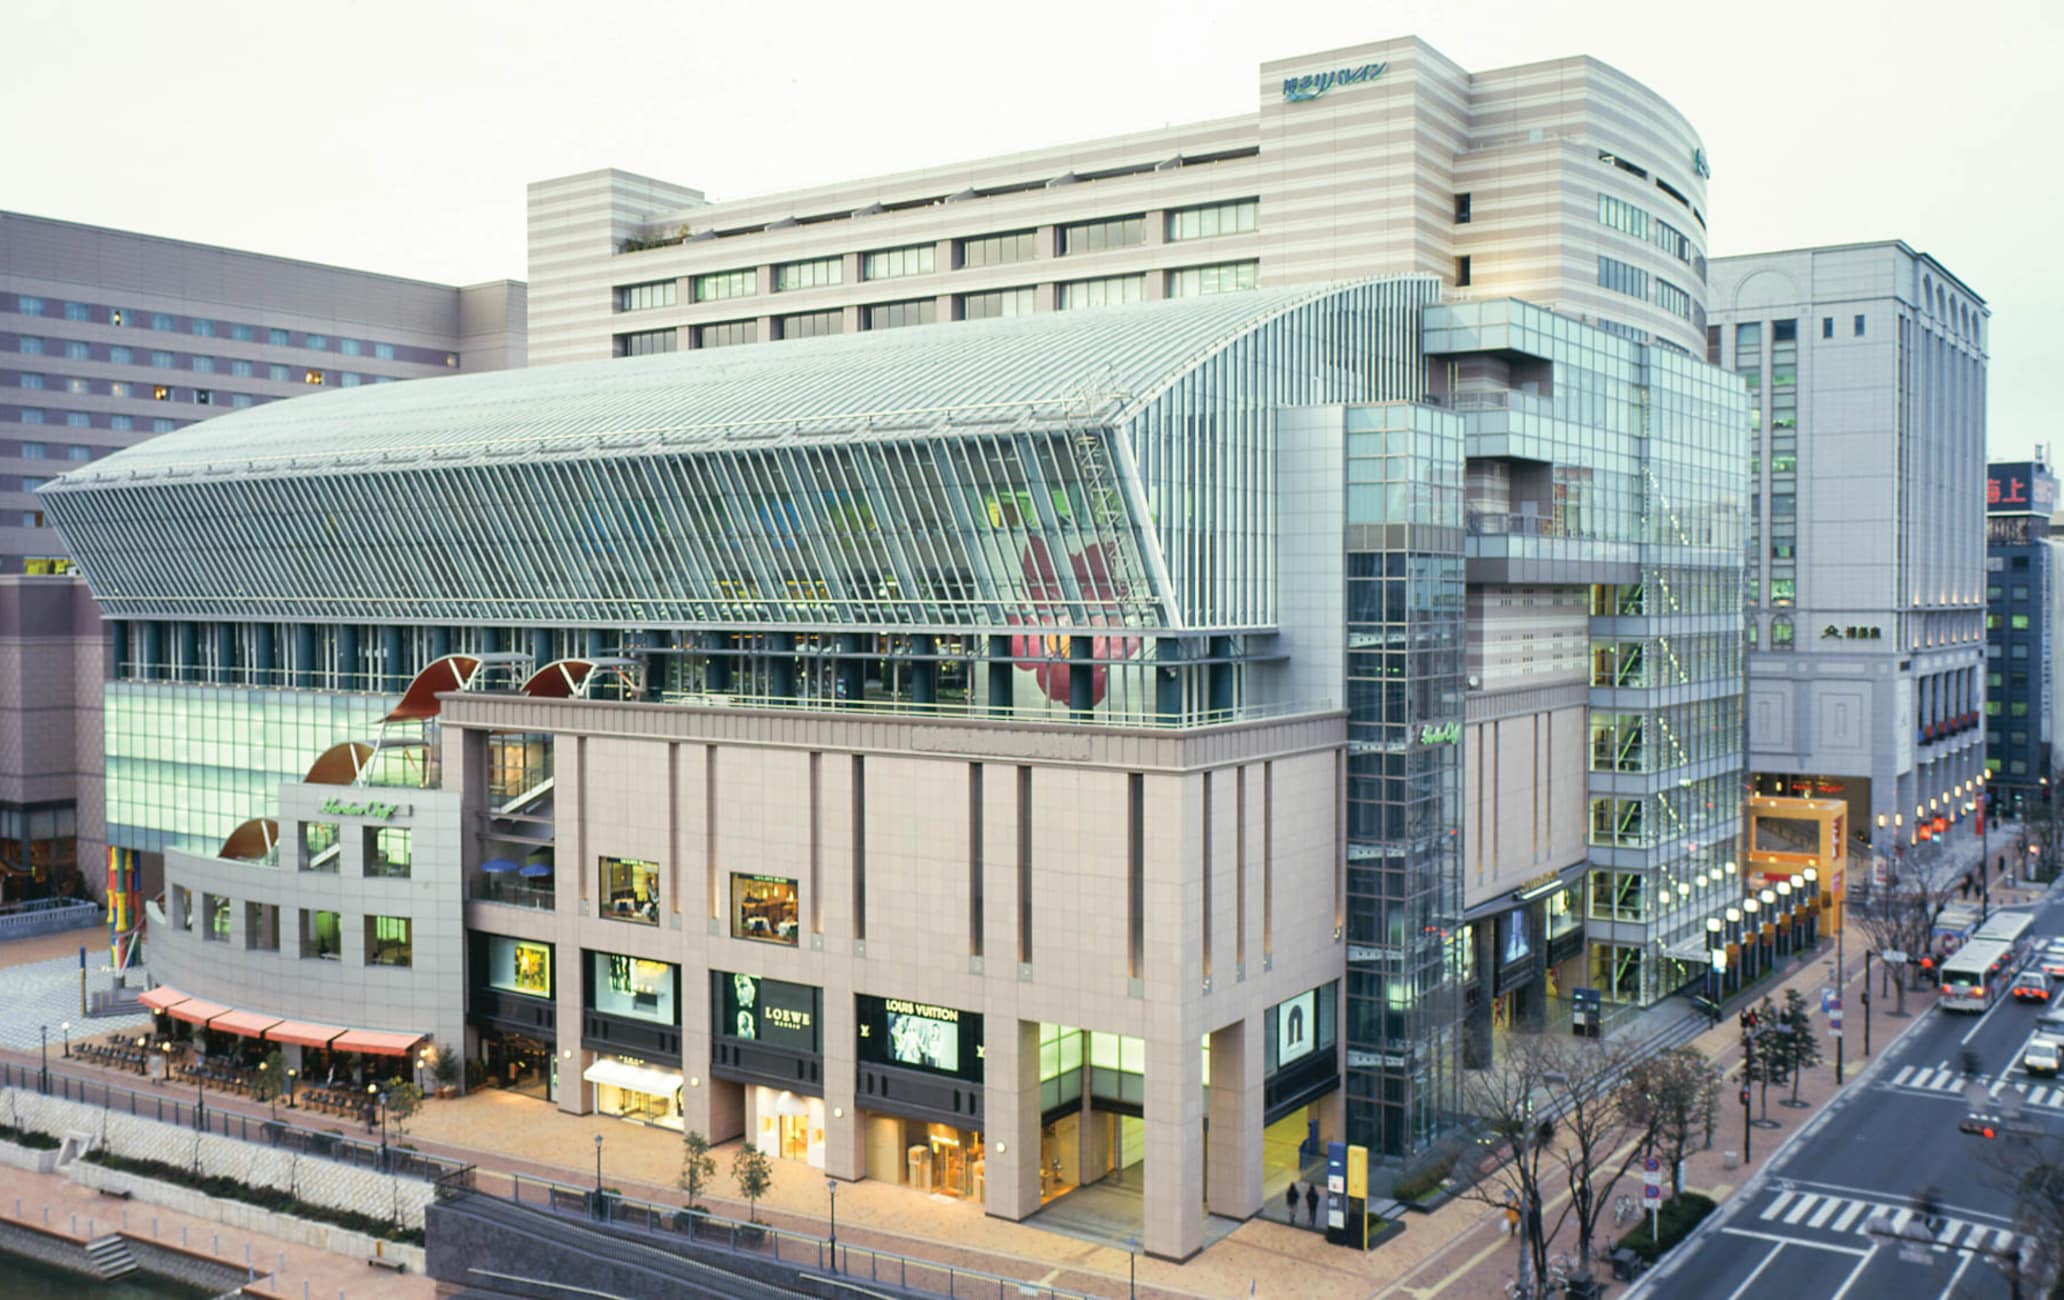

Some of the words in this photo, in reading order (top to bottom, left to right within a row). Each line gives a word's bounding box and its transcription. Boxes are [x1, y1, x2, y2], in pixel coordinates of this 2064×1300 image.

[765, 1006, 810, 1025] LOEWE
[886, 999, 914, 1014] LOUIS
[915, 1004, 959, 1021] VUITTON
